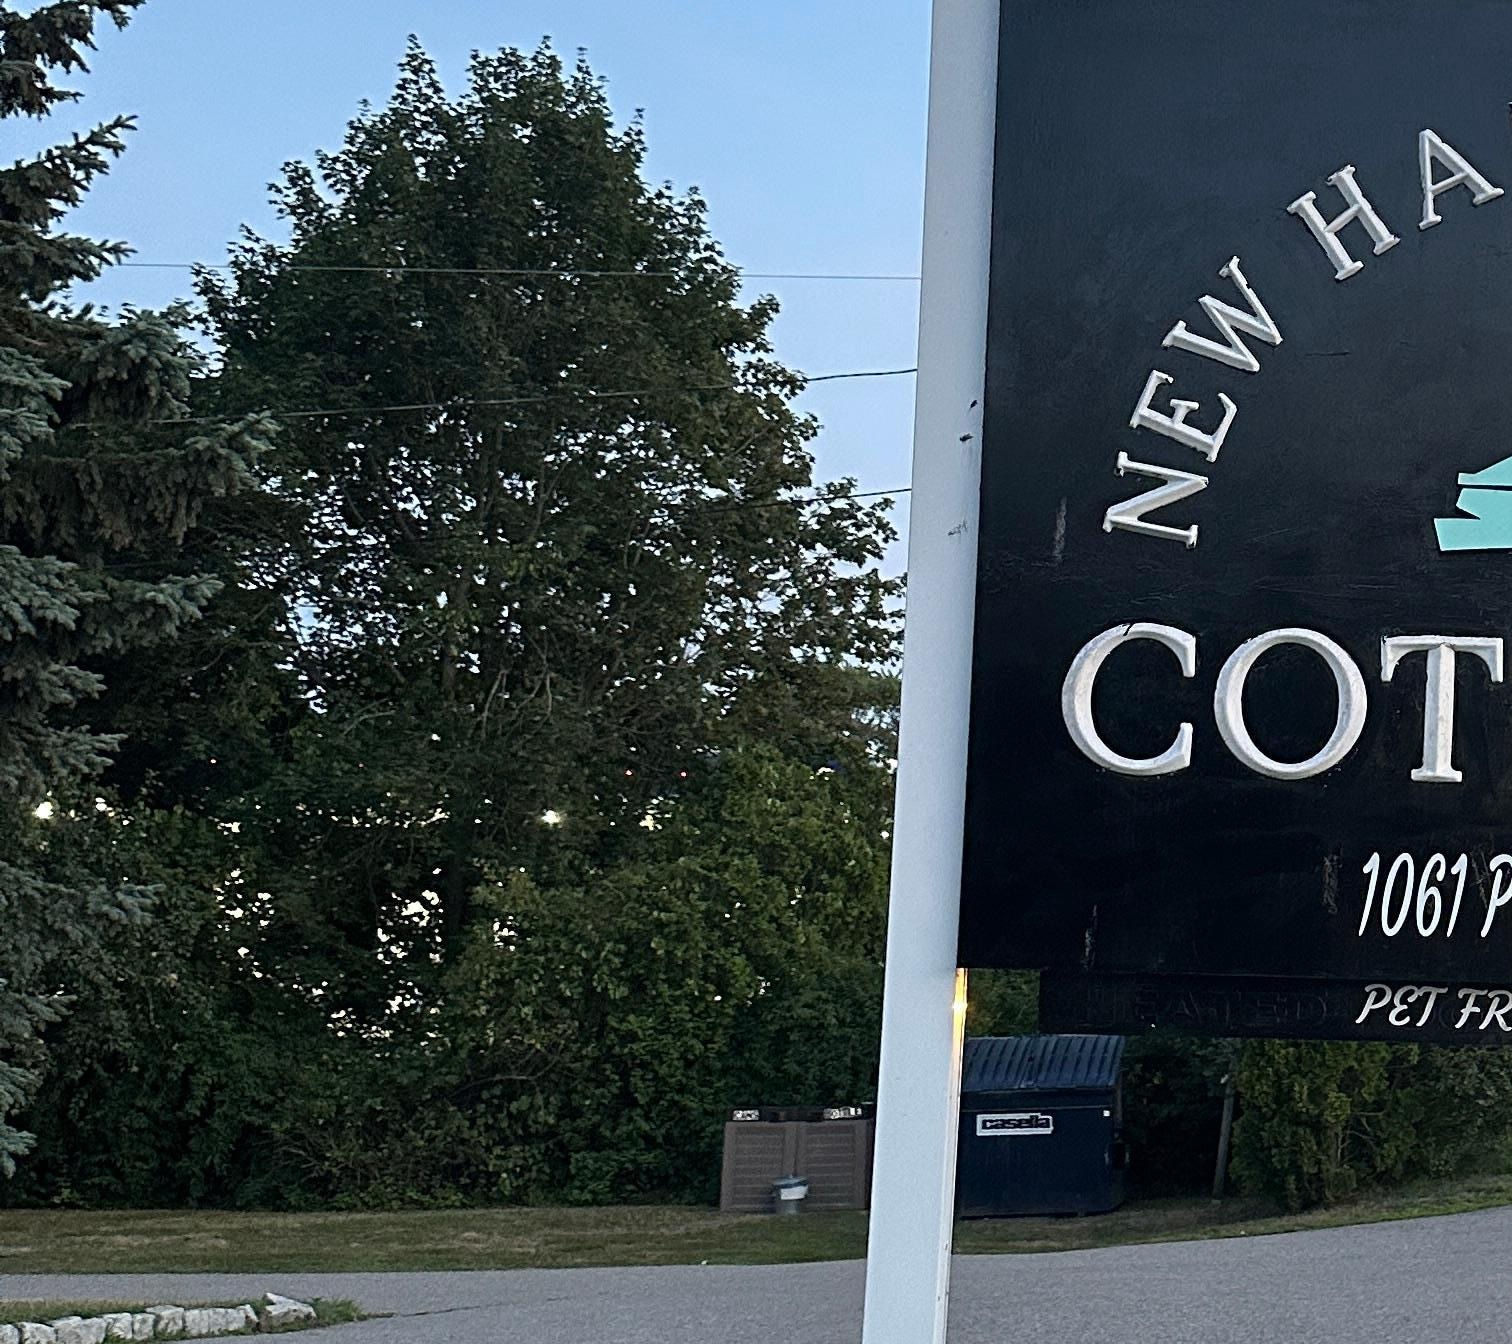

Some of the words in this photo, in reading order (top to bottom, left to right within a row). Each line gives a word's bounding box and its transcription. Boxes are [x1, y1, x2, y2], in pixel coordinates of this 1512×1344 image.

[1103, 256, 1284, 547] NEW
[1358, 852, 1468, 938] 1061
[1355, 984, 1449, 1028] PET
